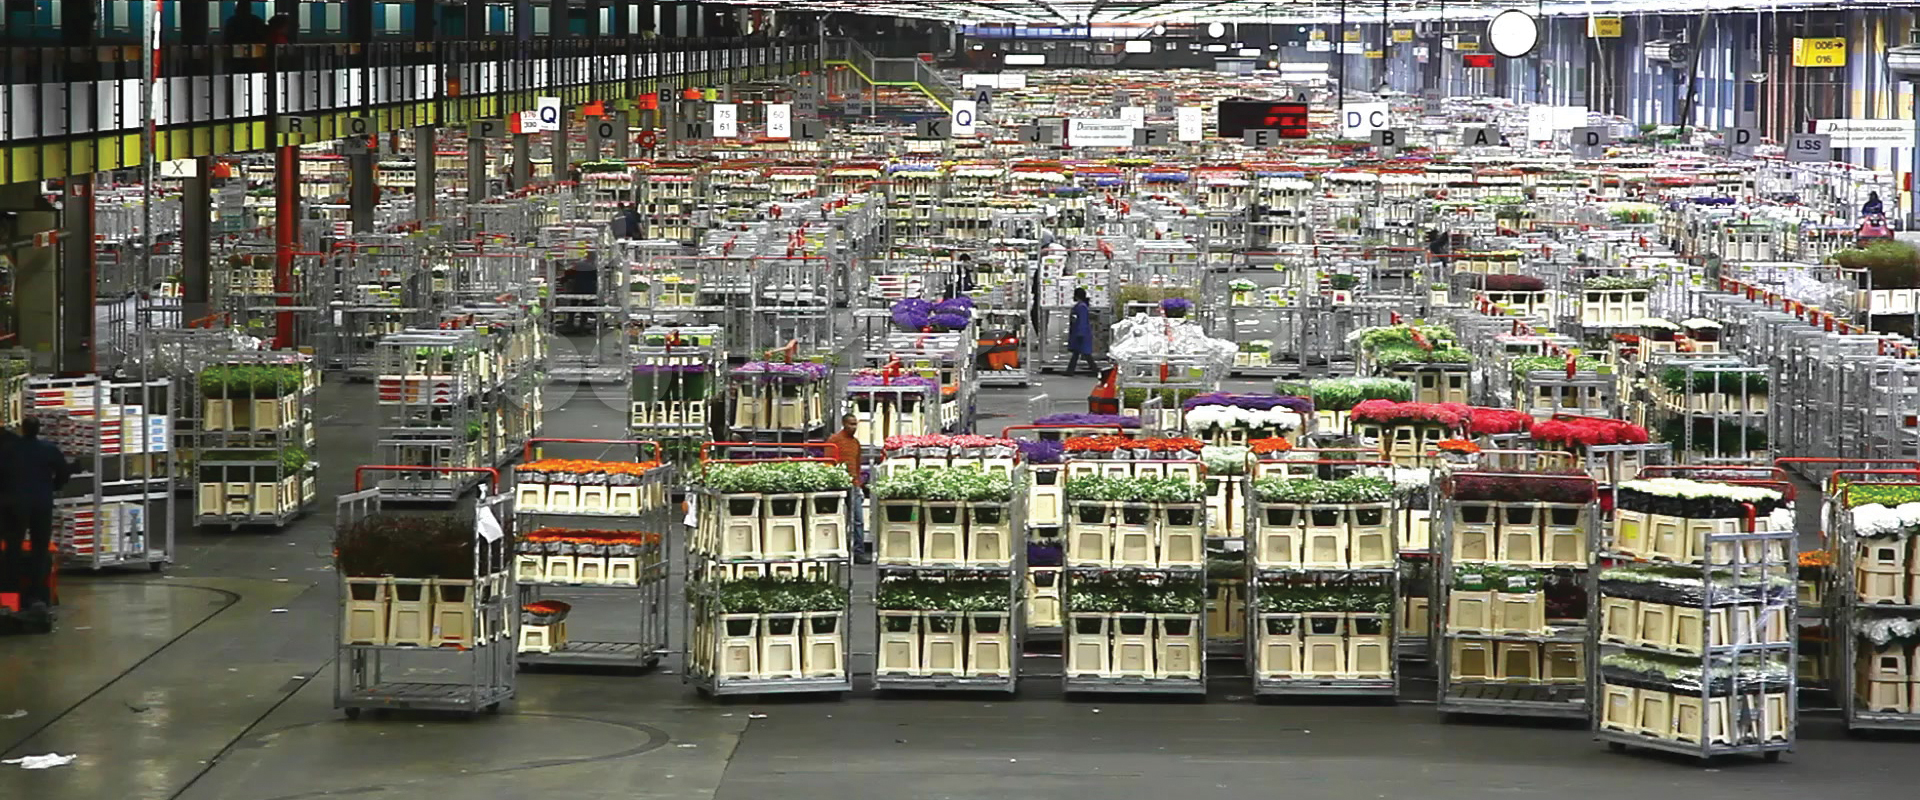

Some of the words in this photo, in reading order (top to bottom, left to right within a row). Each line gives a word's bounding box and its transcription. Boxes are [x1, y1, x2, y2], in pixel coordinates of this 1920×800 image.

[1815, 41, 1833, 50] 006
[1815, 55, 1832, 64] 016
[660, 89, 671, 102] B
[977, 91, 989, 104] A
[1297, 92, 1307, 102] A
[540, 106, 556, 124] Q
[719, 110, 731, 119] 75
[956, 109, 971, 127] Q
[1347, 111, 1361, 128] D
[1369, 111, 1384, 127] C
[289, 117, 302, 133] R
[351, 118, 366, 134] Q
[481, 122, 493, 138] P
[598, 123, 612, 138] O
[687, 123, 702, 139] M
[719, 123, 731, 131] 61
[802, 123, 813, 138] L
[927, 121, 940, 137] K
[1145, 129, 1157, 144] F
[1256, 130, 1268, 146] E
[1382, 130, 1395, 146] B
[1474, 129, 1488, 145] A
[1586, 131, 1599, 146] D
[1736, 129, 1750, 144] D
[1796, 139, 1822, 150] LSS
[172, 160, 184, 175] X
